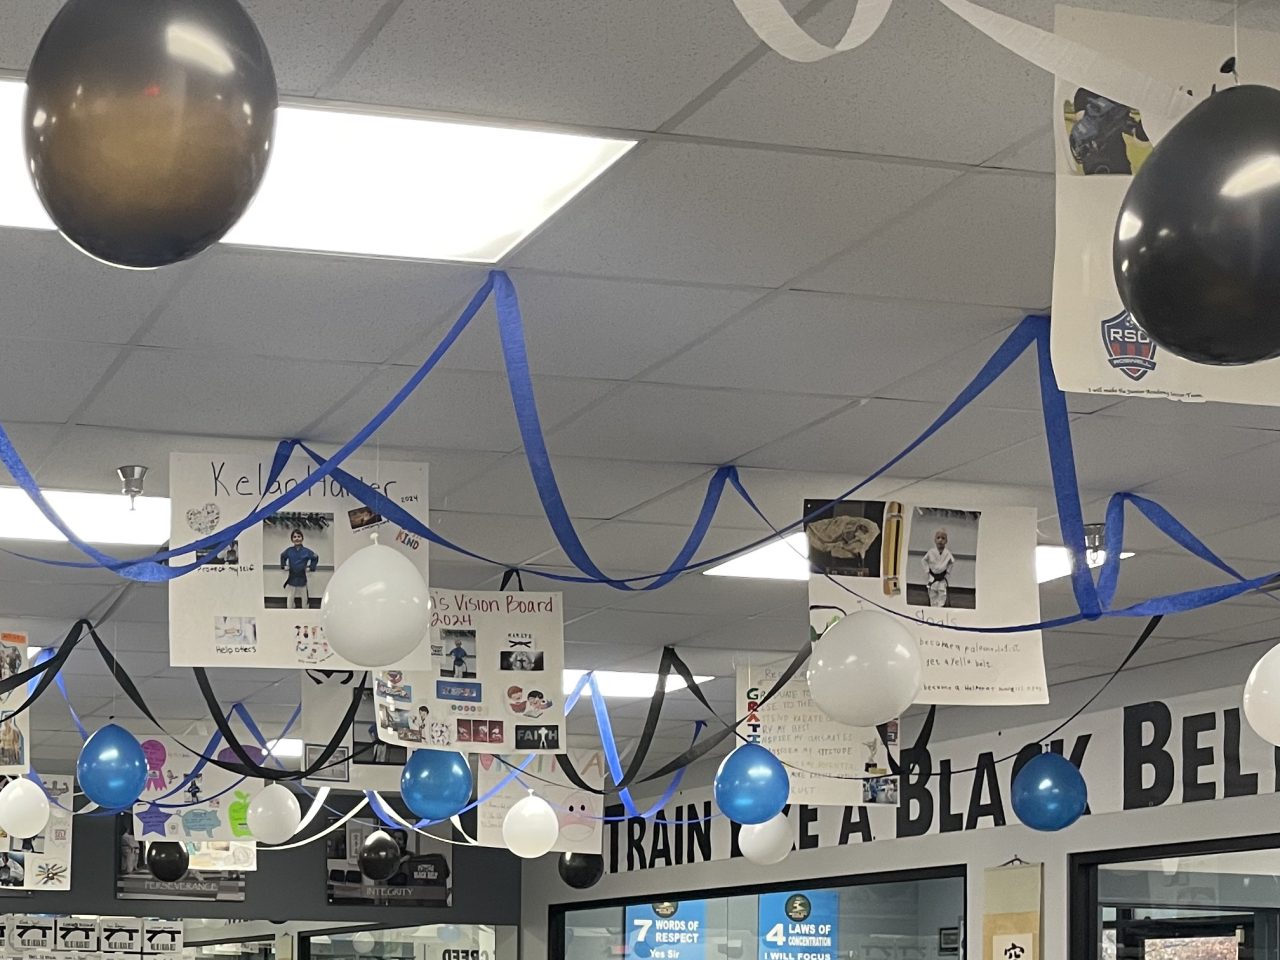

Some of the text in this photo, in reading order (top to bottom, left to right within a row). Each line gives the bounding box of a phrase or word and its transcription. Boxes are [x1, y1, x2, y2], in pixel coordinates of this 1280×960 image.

[396, 529, 420, 550] KIND
[454, 594, 553, 614] Vision Board
[431, 613, 472, 627] 2024
[517, 728, 558, 741] FAITH
[604, 800, 713, 875] TRAIN
[1123, 701, 1280, 811] BEL
[144, 880, 219, 892] PERSEVERANCE
[366, 886, 415, 897] INTEGRITY
[634, 919, 699, 942] 7 WORDS OF
[765, 923, 831, 946] 4 LAWS OF
[655, 932, 699, 943] RESPECT
[787, 936, 832, 947] CONCENTRATION
[650, 949, 680, 959] Yes Sir
[770, 952, 795, 960] WILL
[797, 952, 831, 960] FOCUS
